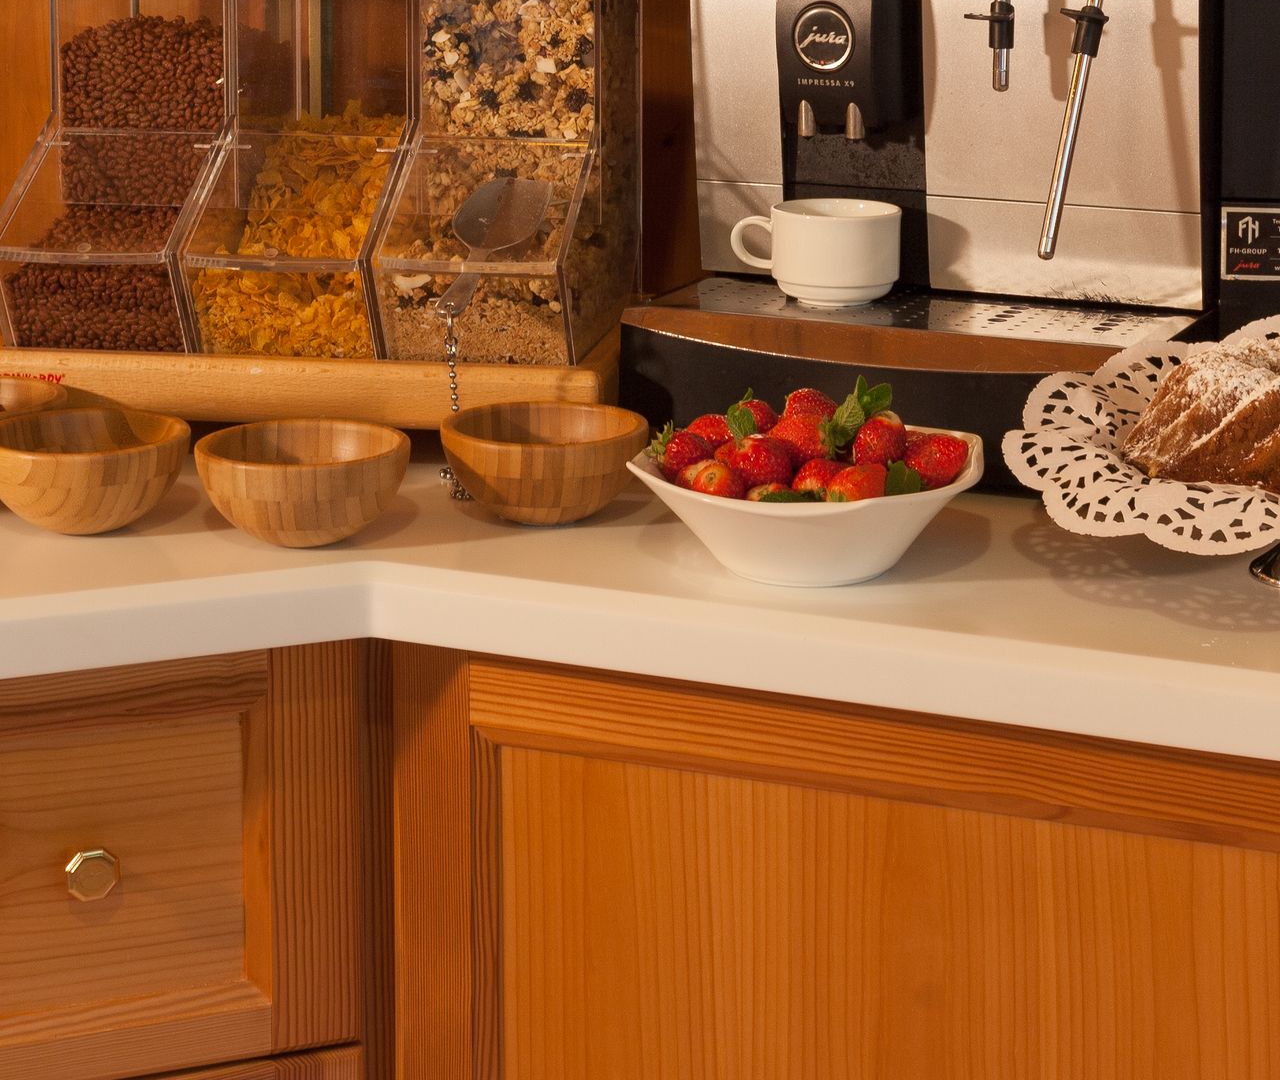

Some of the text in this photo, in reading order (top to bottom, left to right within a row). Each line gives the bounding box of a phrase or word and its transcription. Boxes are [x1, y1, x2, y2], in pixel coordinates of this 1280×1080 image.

[799, 26, 847, 48] jura
[797, 78, 855, 88] IMPRESSA X9
